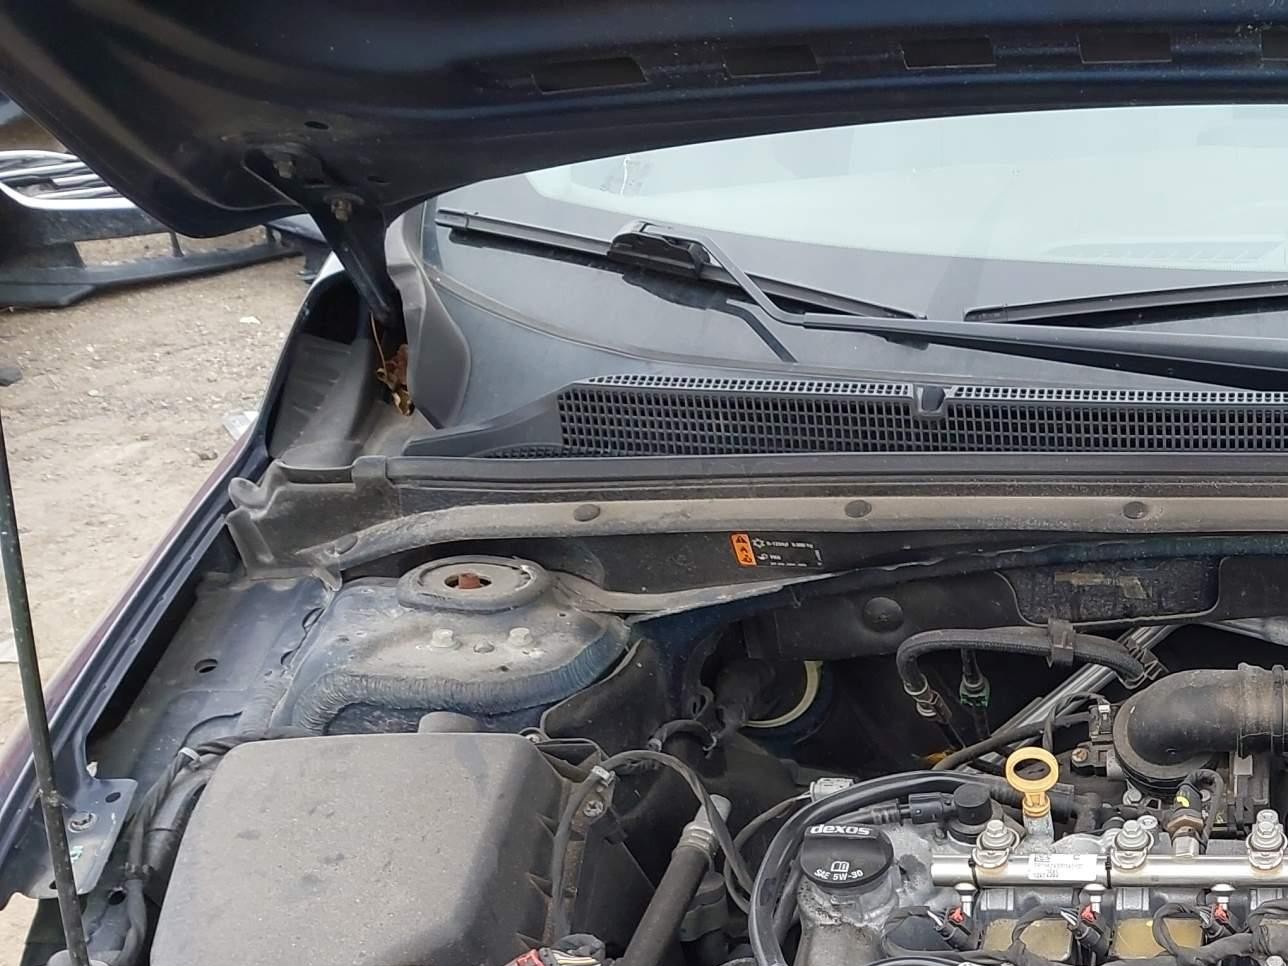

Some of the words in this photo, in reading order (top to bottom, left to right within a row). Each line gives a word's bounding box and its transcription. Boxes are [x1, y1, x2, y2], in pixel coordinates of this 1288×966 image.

[810, 824, 873, 835] dexos
[814, 869, 831, 879] SAE
[833, 869, 864, 880] 5W-30
